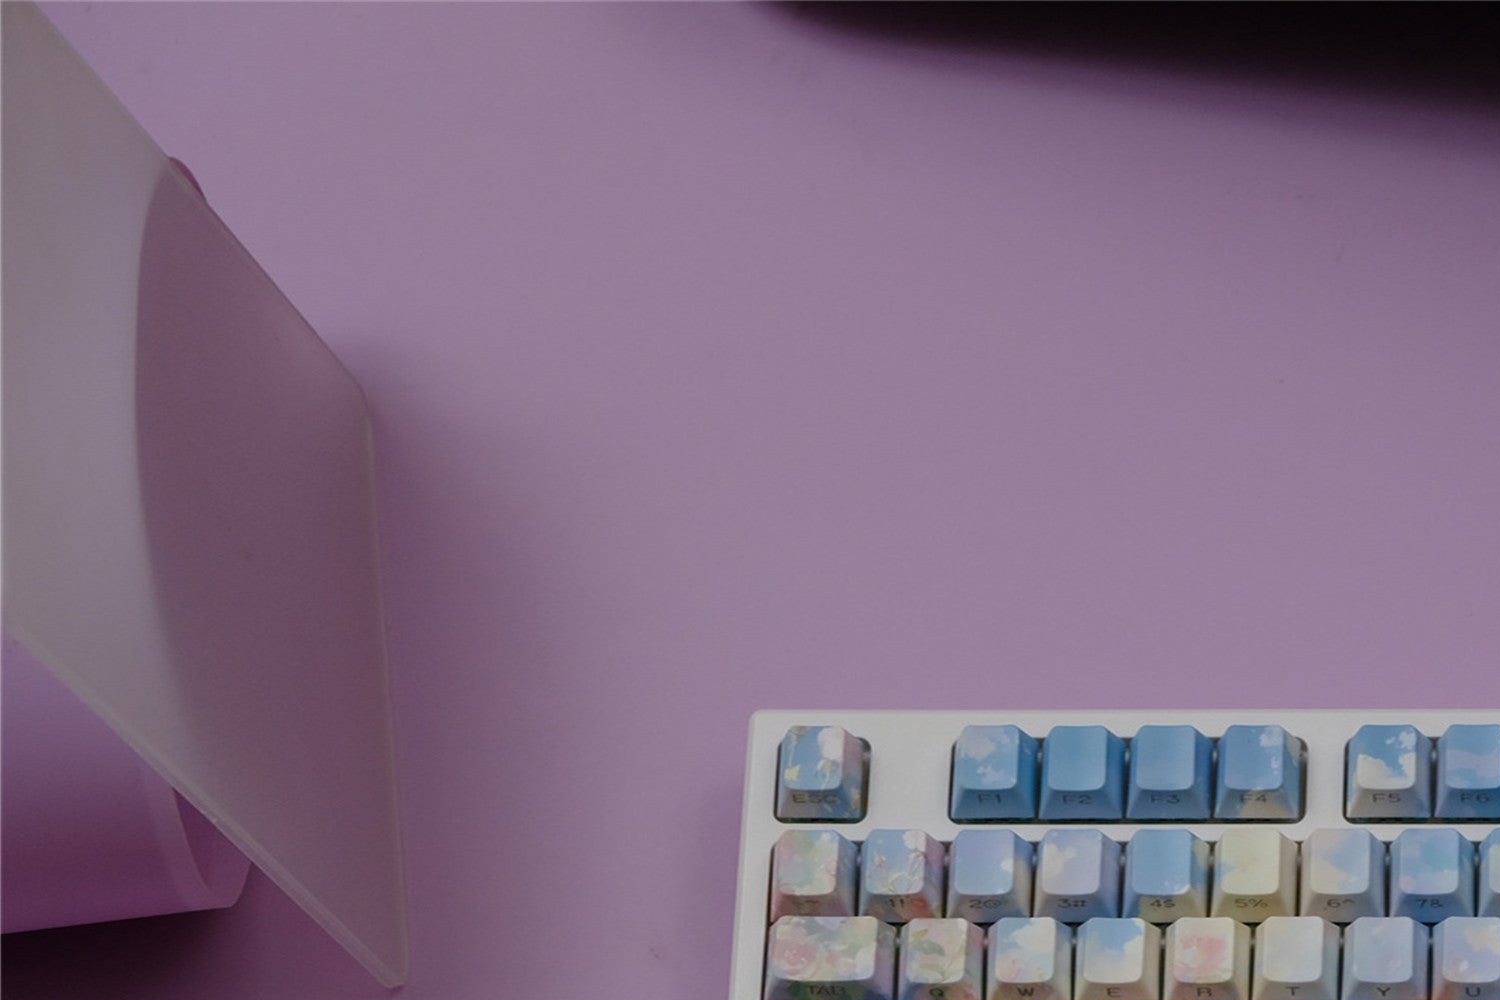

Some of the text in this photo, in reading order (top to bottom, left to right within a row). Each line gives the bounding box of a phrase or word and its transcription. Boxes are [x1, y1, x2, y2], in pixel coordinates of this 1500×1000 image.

[792, 794, 841, 805] ESC
[979, 795, 1001, 805] F1
[1064, 795, 1093, 805] F2
[1151, 795, 1180, 805] F3
[1240, 794, 1269, 804] F4
[1372, 793, 1402, 803] F5
[1460, 793, 1491, 803] F6
[1016, 985, 1036, 997] W
[1107, 986, 1120, 997] E
[1197, 986, 1211, 997] R
[1286, 986, 1300, 996] T
[1376, 986, 1393, 997] Y
[1465, 986, 1481, 997] U
